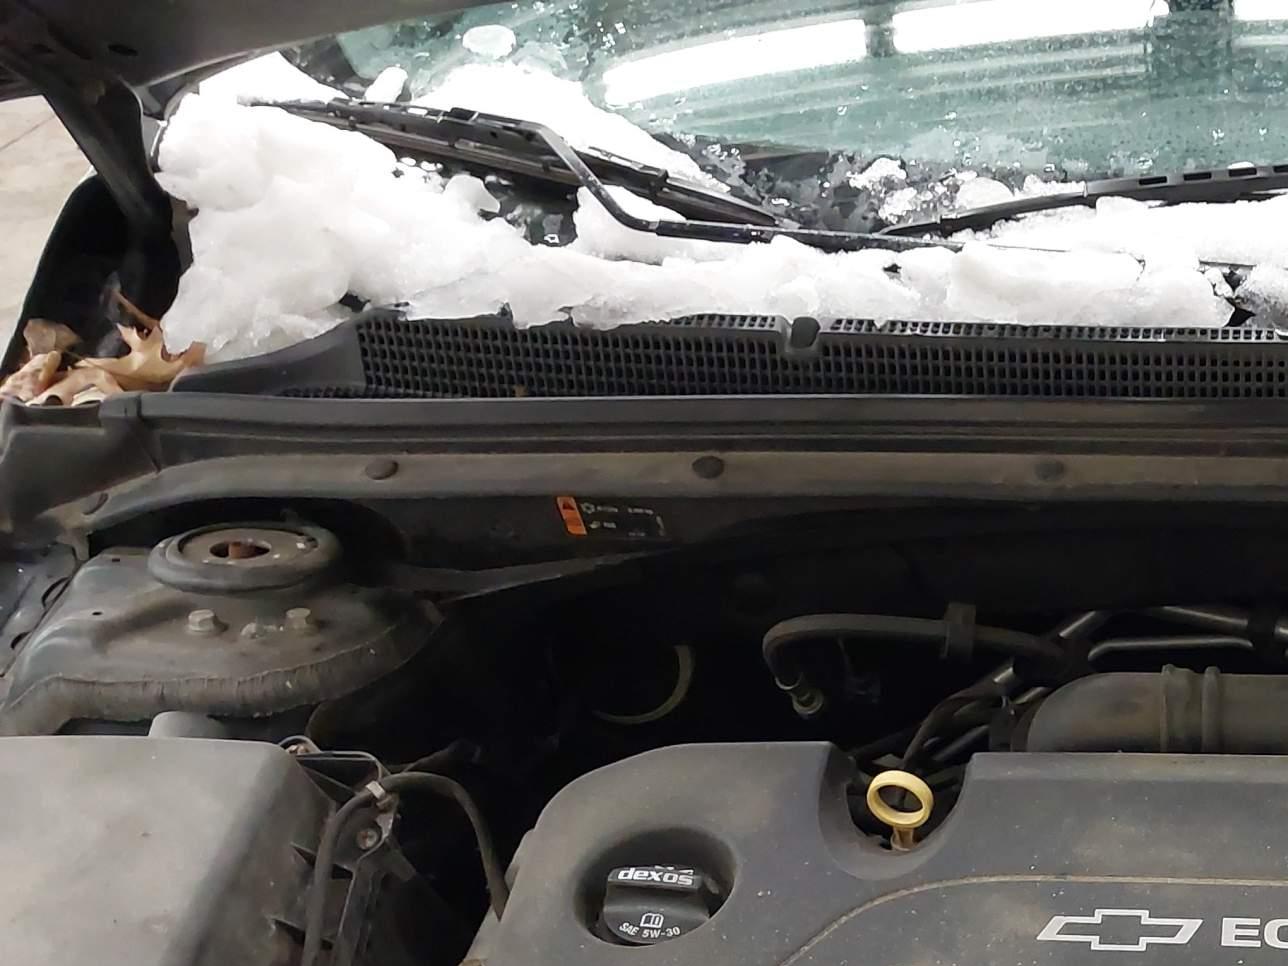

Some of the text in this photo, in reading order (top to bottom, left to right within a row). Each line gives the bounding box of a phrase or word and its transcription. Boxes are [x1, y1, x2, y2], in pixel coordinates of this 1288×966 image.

[618, 867, 694, 885] dexos
[619, 922, 681, 938] SAE 5W-30
